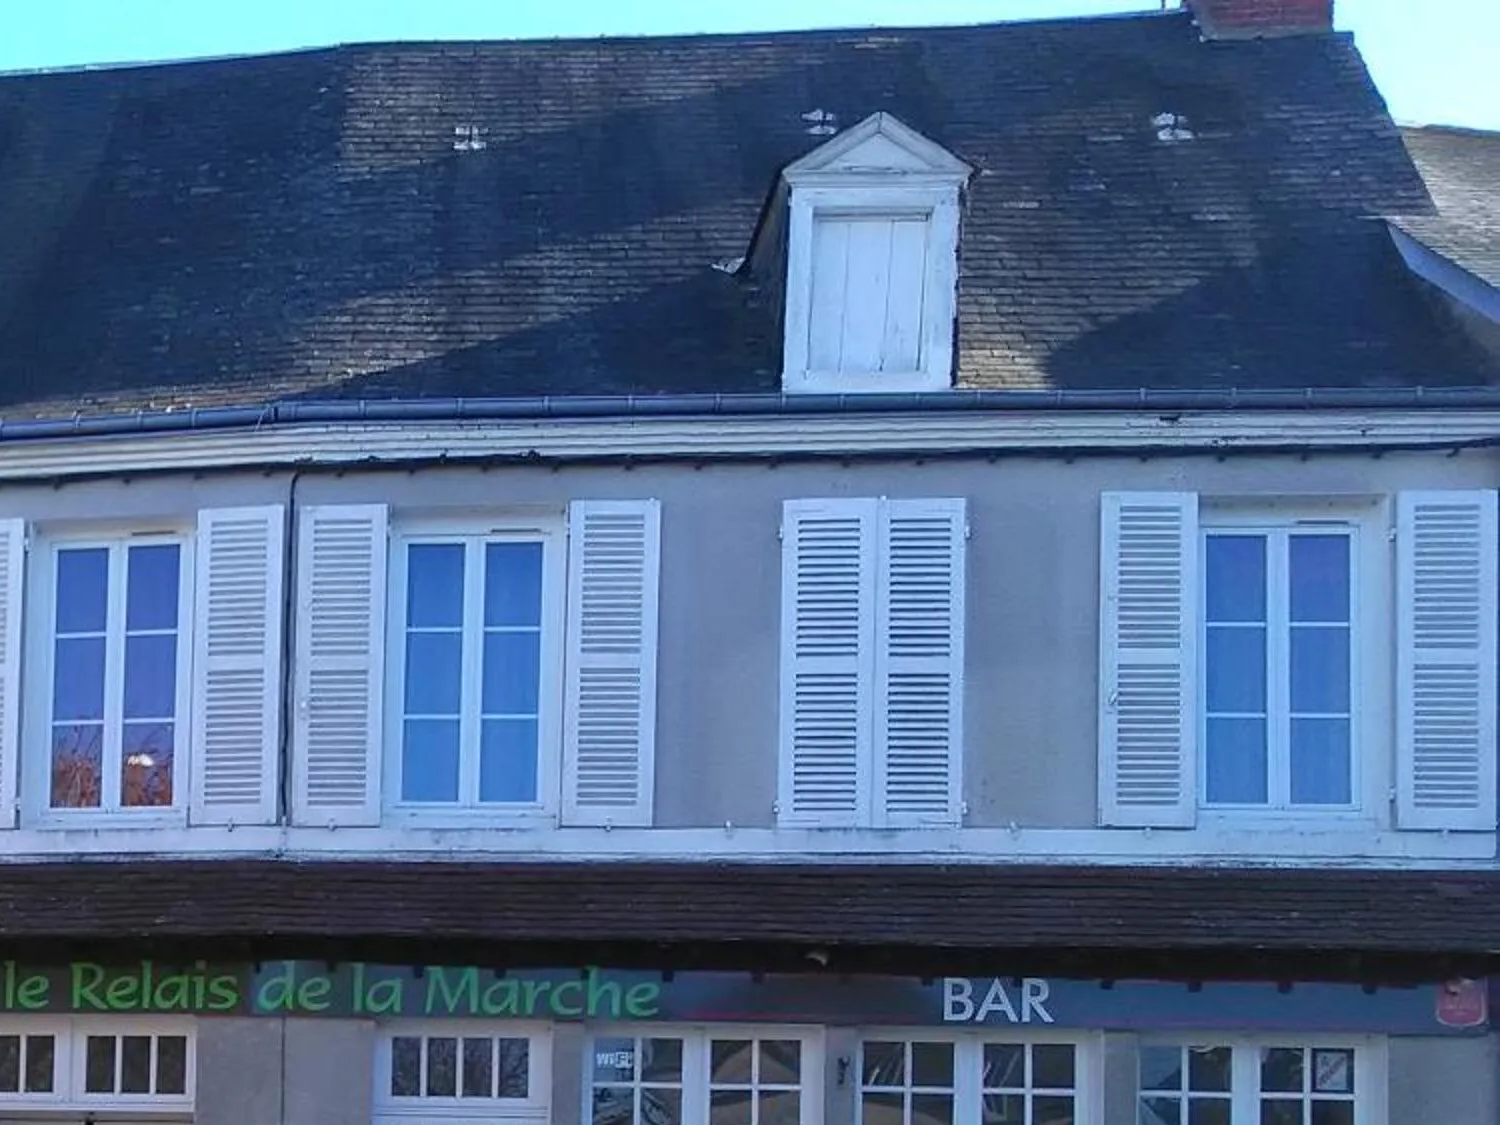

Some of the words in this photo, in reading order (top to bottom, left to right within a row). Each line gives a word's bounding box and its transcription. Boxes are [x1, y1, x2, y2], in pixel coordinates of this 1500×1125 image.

[4, 961, 49, 1009] le
[70, 961, 238, 1011] Relais
[257, 961, 330, 1011] de
[354, 963, 403, 1013] la
[426, 966, 660, 1016] Marche
[943, 977, 1055, 1022] BAR
